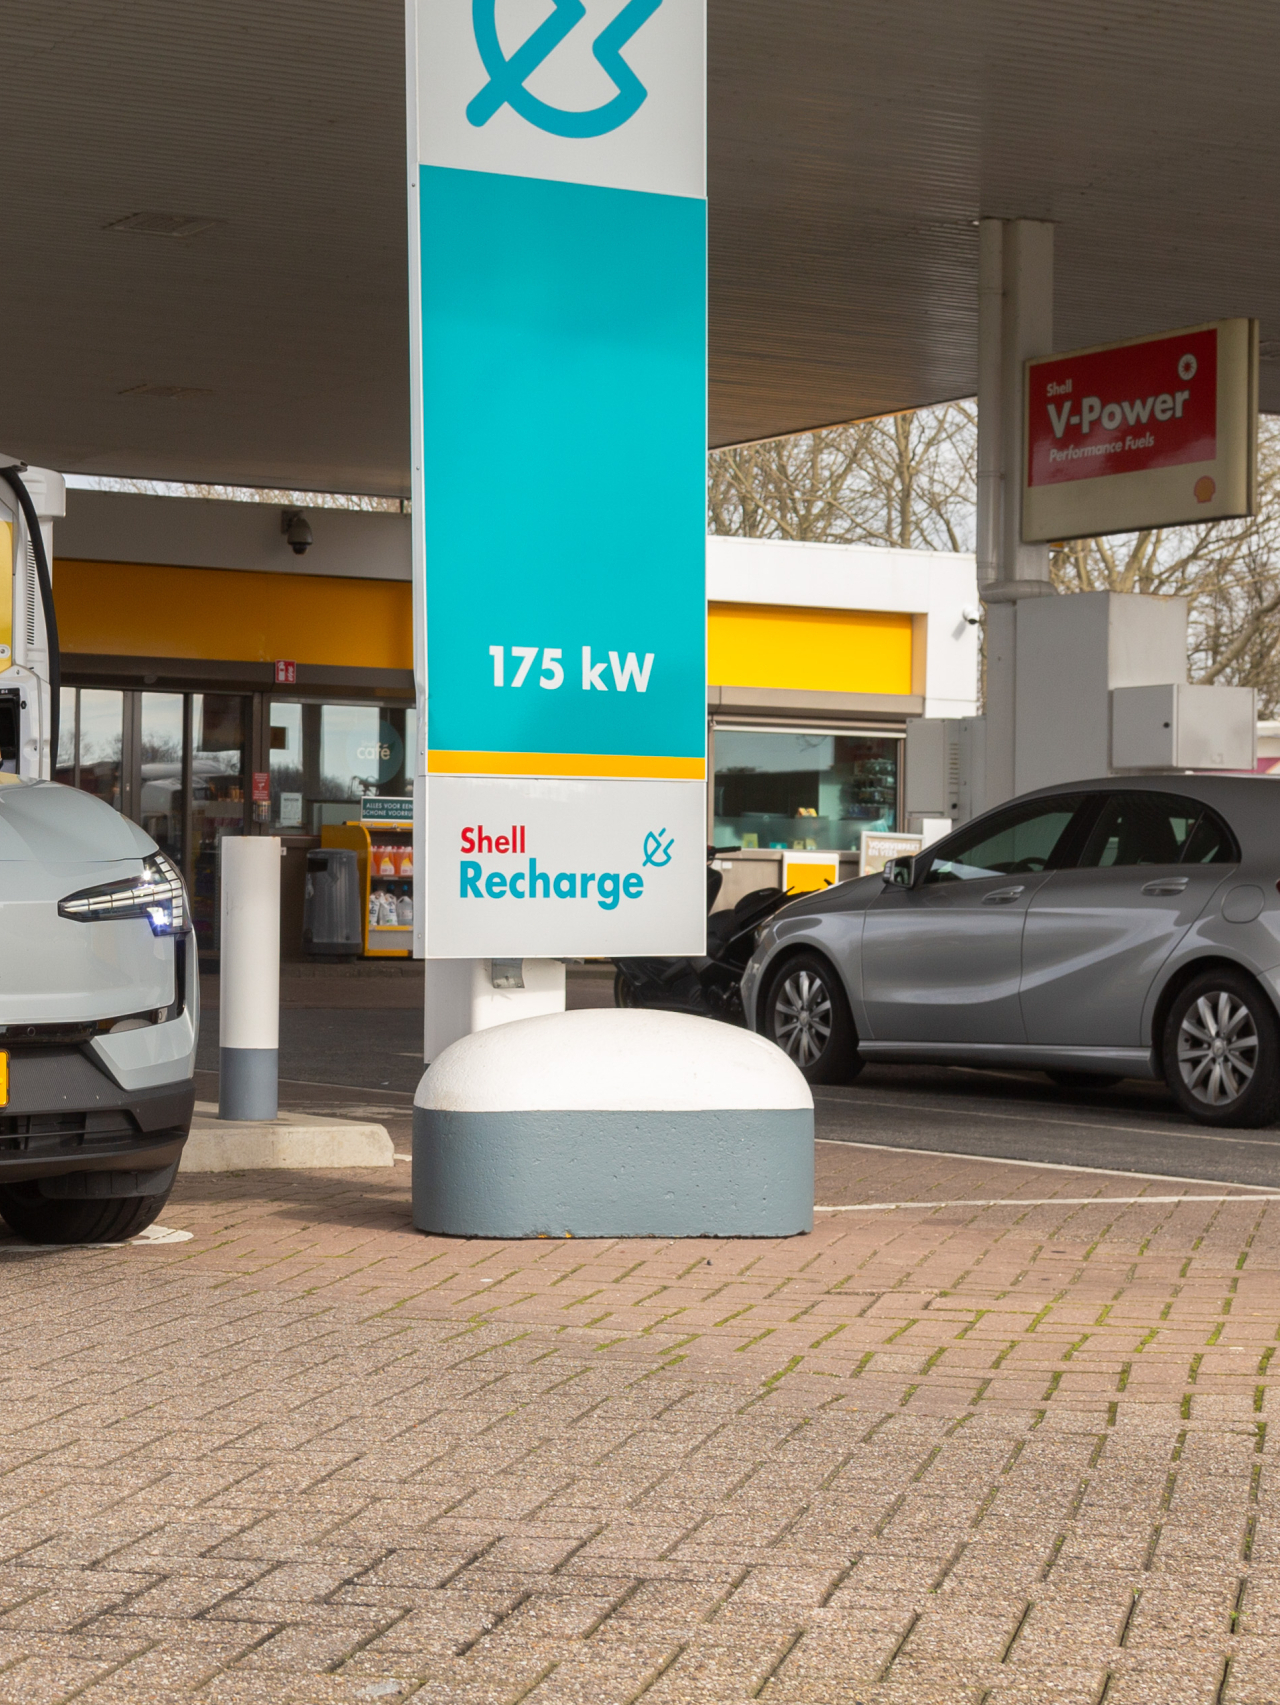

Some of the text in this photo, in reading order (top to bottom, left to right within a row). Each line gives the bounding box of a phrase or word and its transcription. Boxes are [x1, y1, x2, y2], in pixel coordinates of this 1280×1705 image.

[1046, 378, 1073, 397] Shell
[1046, 389, 1190, 439] V-Power
[1049, 431, 1155, 462] Performance Fuels
[488, 645, 655, 693] 175 kW
[356, 742, 391, 760] café
[460, 825, 526, 854] Shell
[460, 857, 644, 911] Recharge
